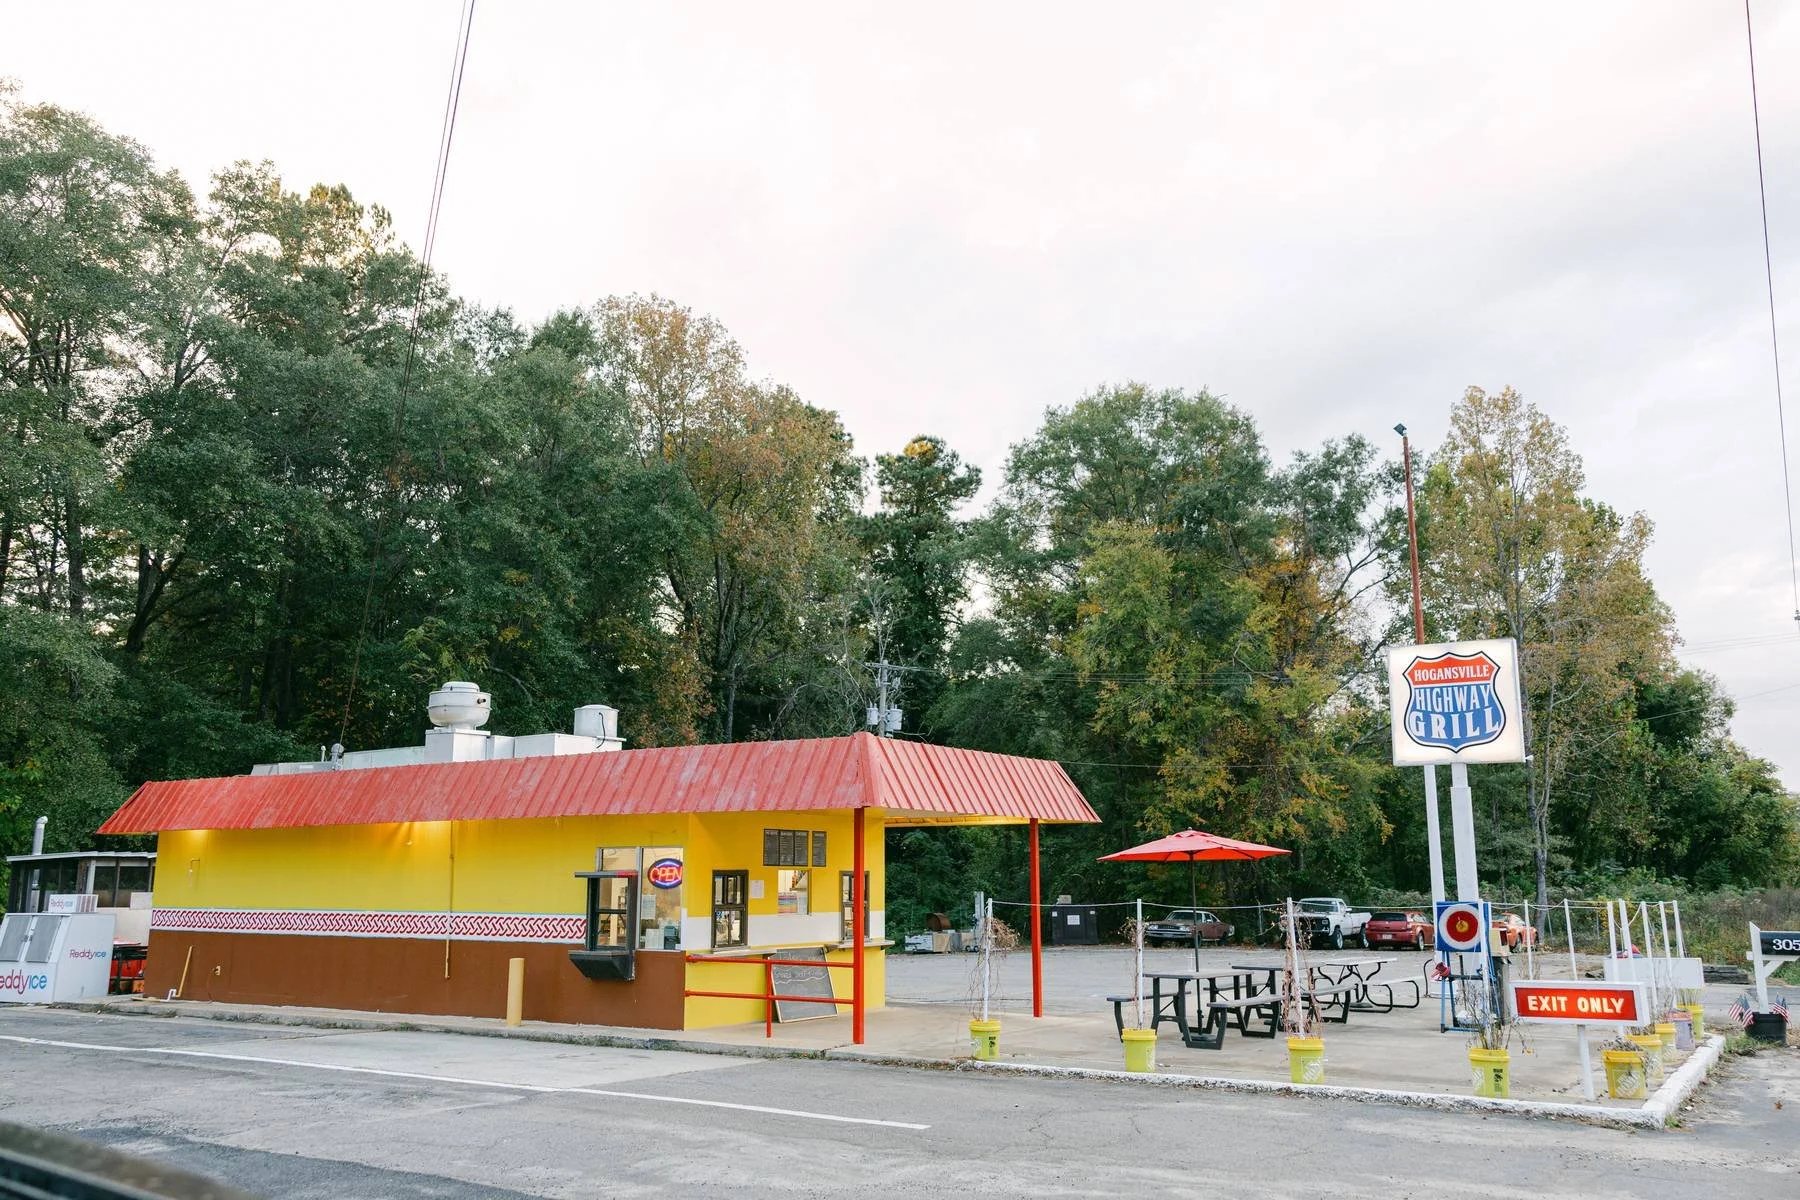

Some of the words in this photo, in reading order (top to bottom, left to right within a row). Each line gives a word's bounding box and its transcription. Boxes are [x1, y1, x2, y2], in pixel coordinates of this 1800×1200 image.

[1414, 664, 1490, 681] HOGANSVILLE
[1415, 685, 1491, 713] HIGHWAY
[1410, 706, 1499, 740] GRILL
[649, 866, 683, 882] OPEN
[1772, 938, 1800, 951] 305
[1527, 995, 1568, 1012] EXIT
[1577, 996, 1625, 1014] ONLY
